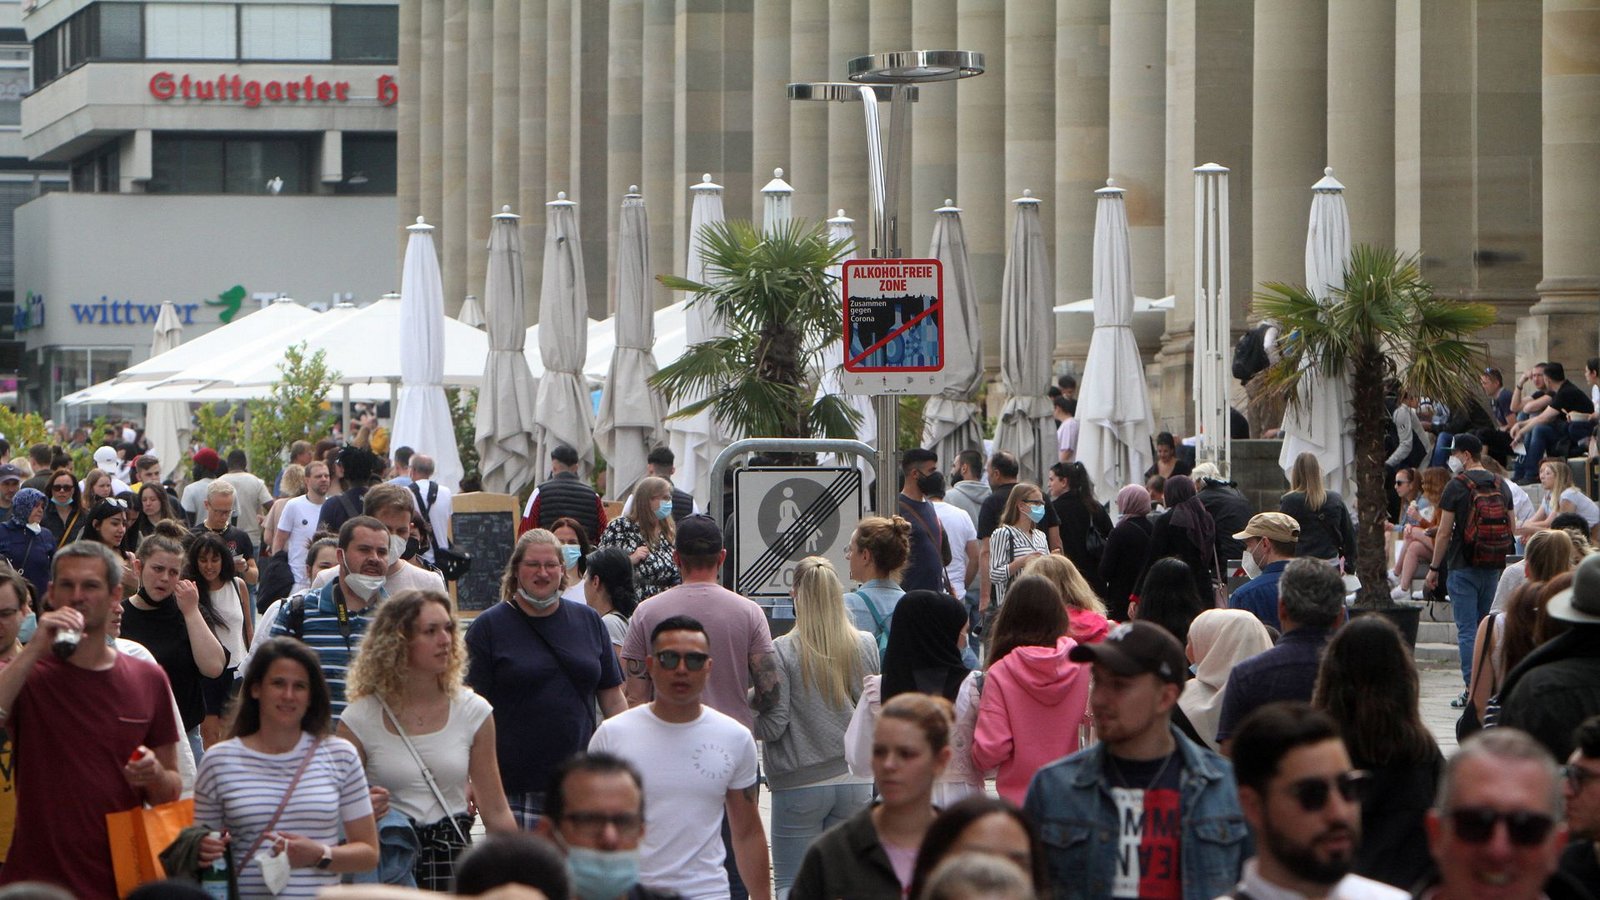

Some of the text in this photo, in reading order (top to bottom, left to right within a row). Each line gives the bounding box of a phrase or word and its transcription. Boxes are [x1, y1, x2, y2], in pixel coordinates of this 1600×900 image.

[149, 71, 350, 108] Stuttgarter
[853, 266, 933, 279] ALKOHOLFREIE
[879, 279, 907, 292] ZONE
[70, 296, 200, 325] wittwr
[850, 307, 872, 316] gegen
